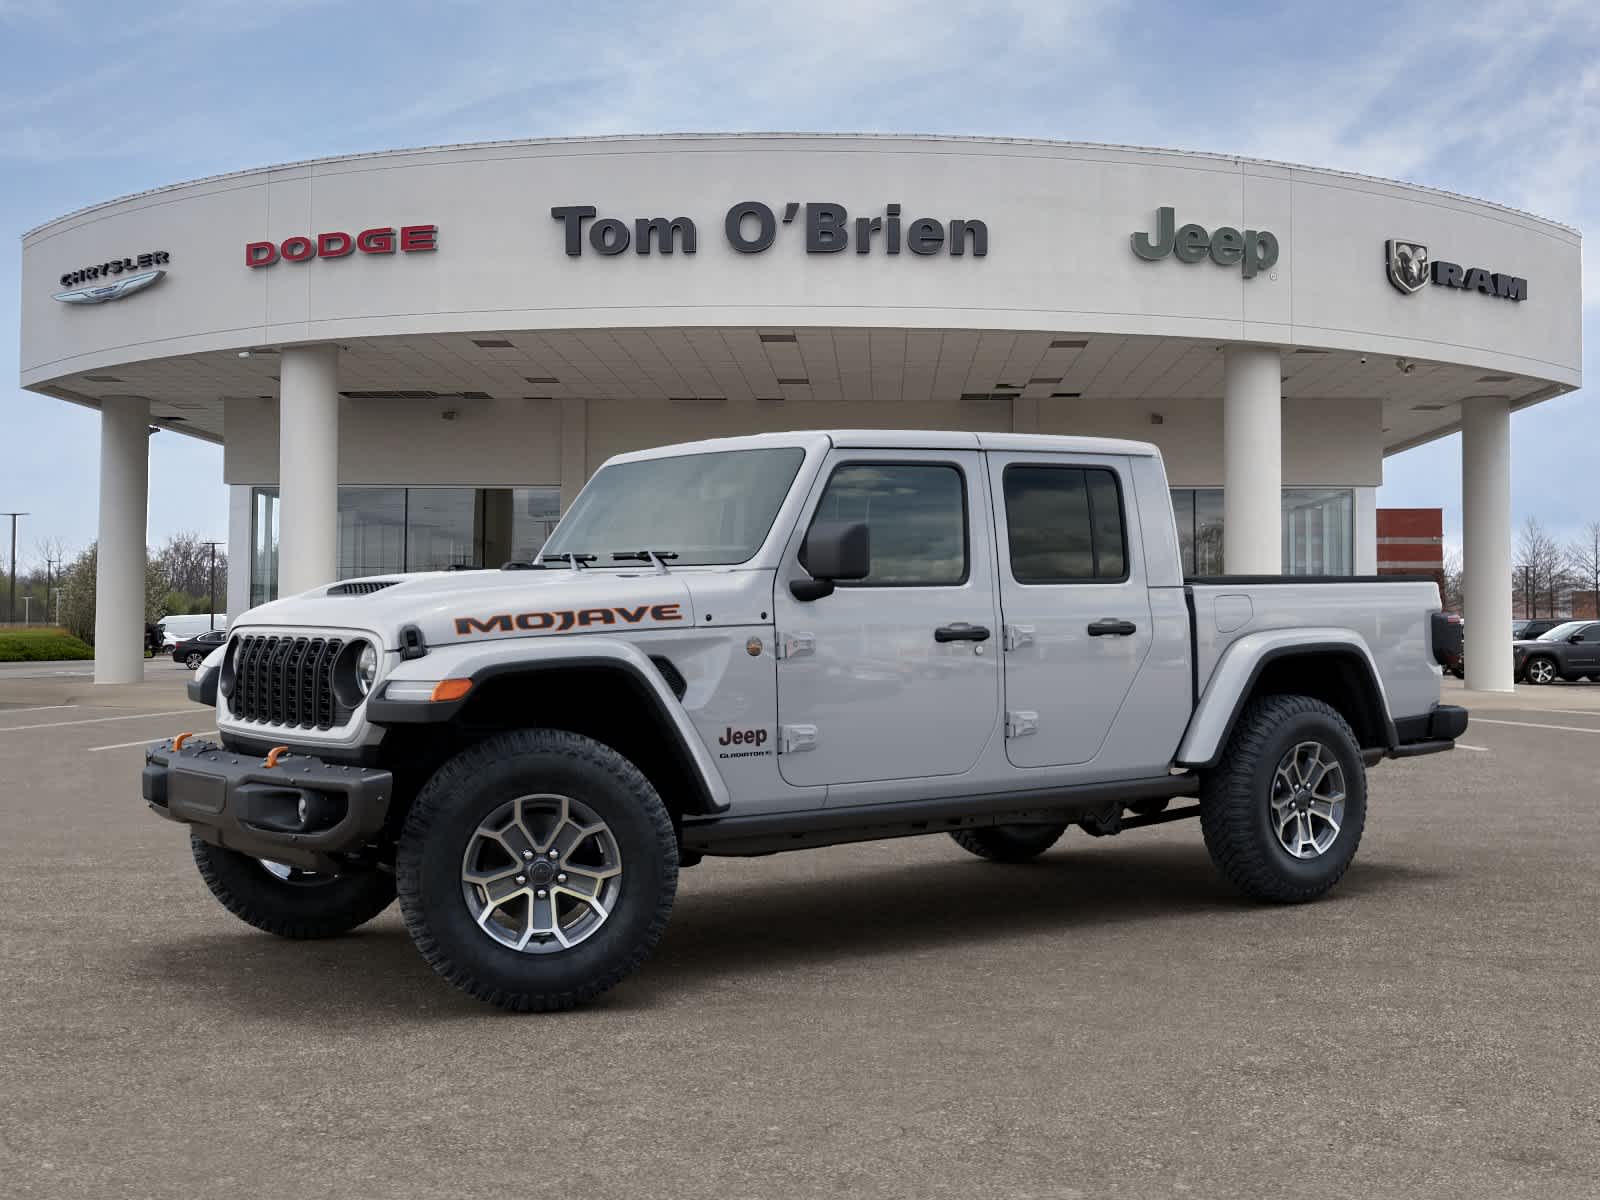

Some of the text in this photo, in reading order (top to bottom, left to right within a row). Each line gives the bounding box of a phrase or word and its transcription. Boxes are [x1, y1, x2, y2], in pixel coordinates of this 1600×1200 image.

[245, 224, 438, 269] DODGE
[551, 201, 989, 257] Tom O’Brien
[1130, 206, 1279, 280] Jeep
[59, 249, 171, 289] CHRYSLER
[1430, 260, 1528, 301] RAM
[455, 604, 683, 635] MOJAVE
[719, 727, 768, 747] Jeep
[719, 750, 765, 759] GLADIATOR
